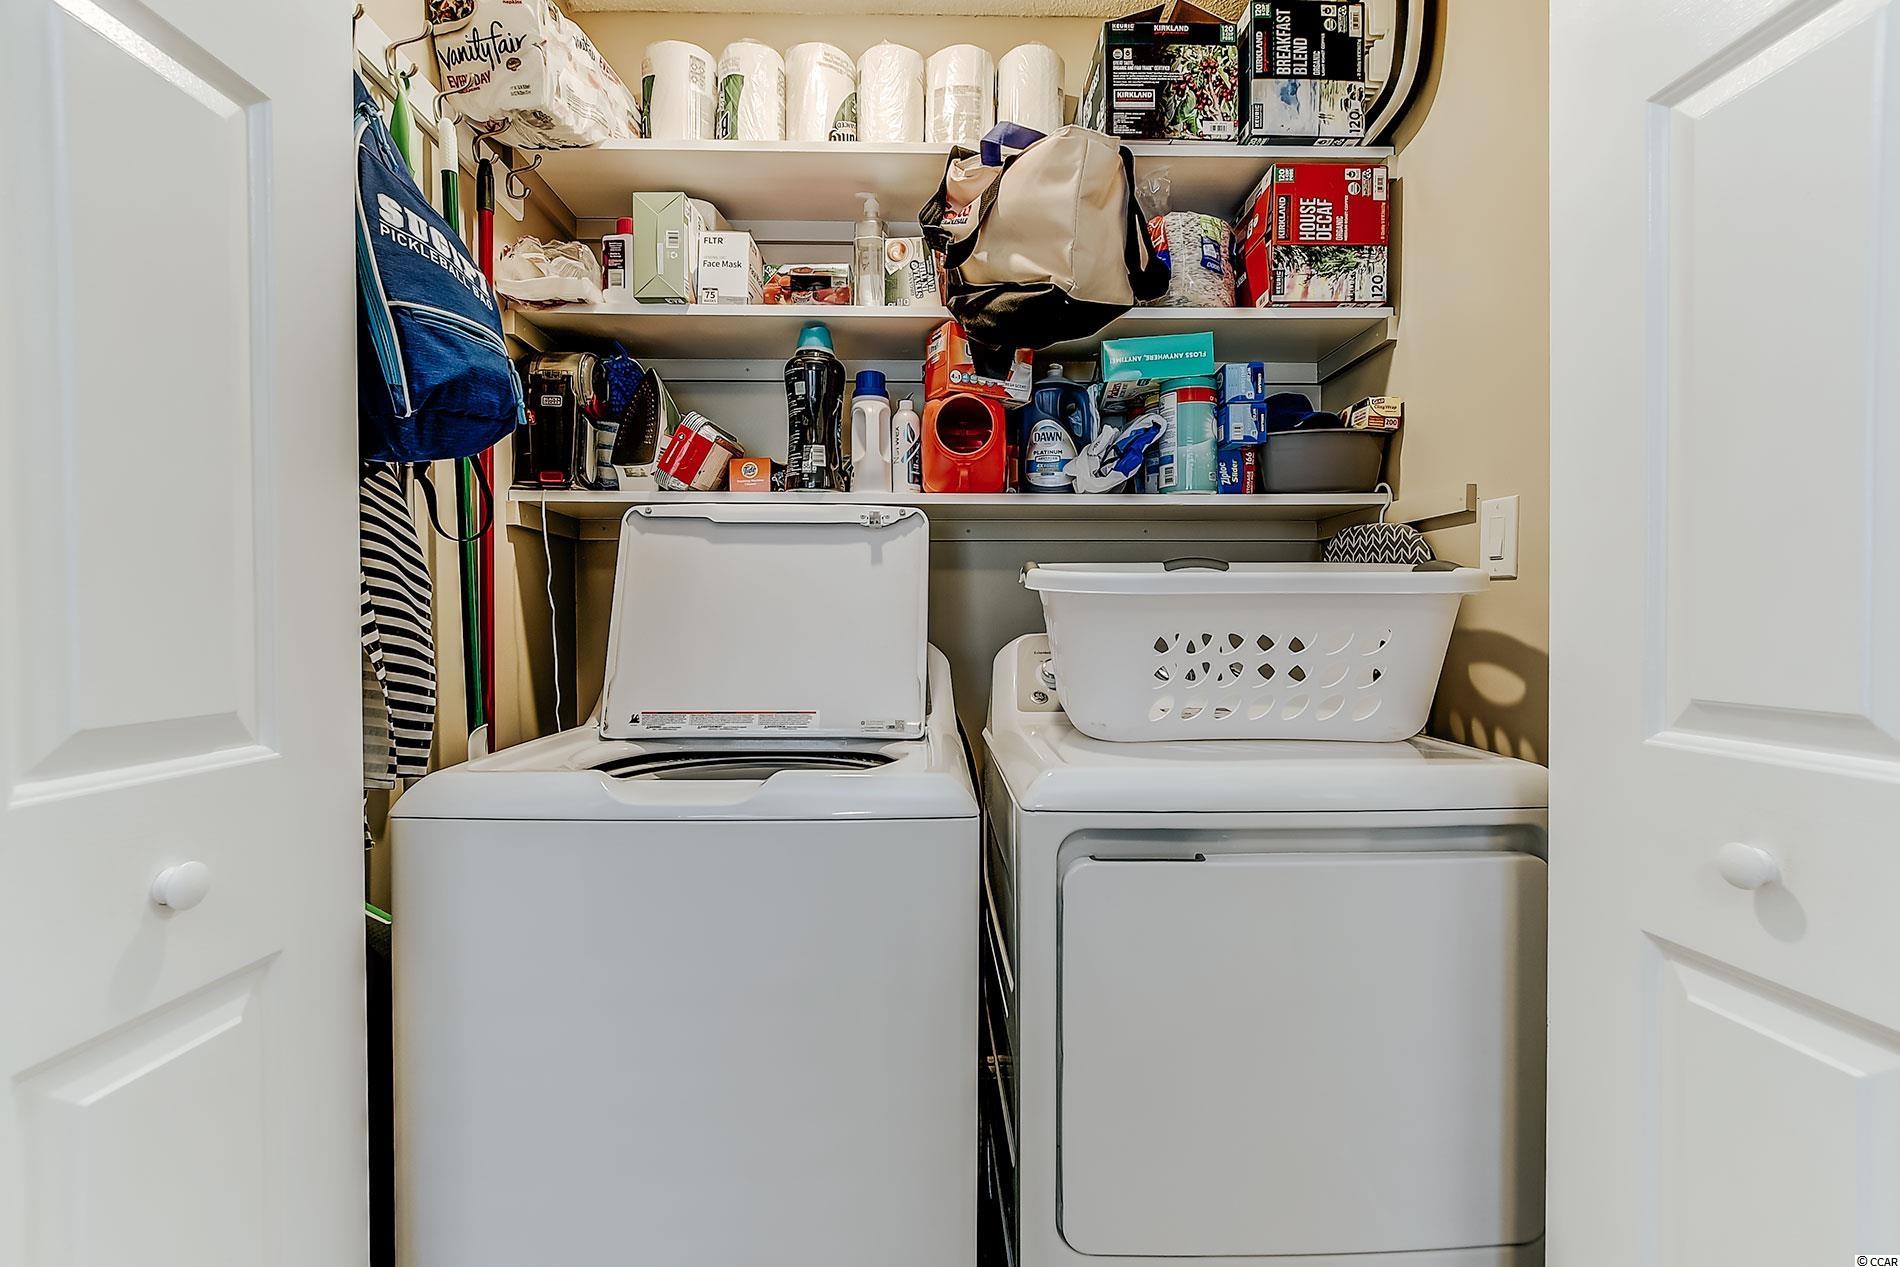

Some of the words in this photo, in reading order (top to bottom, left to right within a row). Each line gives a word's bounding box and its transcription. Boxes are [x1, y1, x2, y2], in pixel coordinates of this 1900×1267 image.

[1255, 31, 1263, 73] KIRKLAND
[1276, 8, 1291, 75] BREAKFAST
[1293, 37, 1308, 75] BLEND
[447, 70, 491, 88] EVERDAY
[1349, 110, 1361, 134] 120
[1278, 196, 1286, 239] KIRKLAND
[1299, 197, 1316, 241] HOUSE
[1316, 198, 1333, 241] DECAF
[1336, 215, 1344, 241] ORGANIC
[703, 237, 724, 245] FLTR
[379, 224, 471, 290] PICKLEBALL
[471, 285, 494, 311] BAG
[703, 260, 720, 268] Face
[721, 260, 742, 268] Mask
[705, 291, 716, 299] 75
[1371, 275, 1383, 298] 120
[1143, 352, 1184, 362] ANYWHERE,
[1185, 351, 1207, 359] FLOSS
[1385, 418, 1398, 426] 200
[1034, 431, 1062, 442] DAWN
[1245, 451, 1253, 465] 166
[1219, 461, 1231, 486] Ziploc
[1231, 458, 1239, 484] Slider
